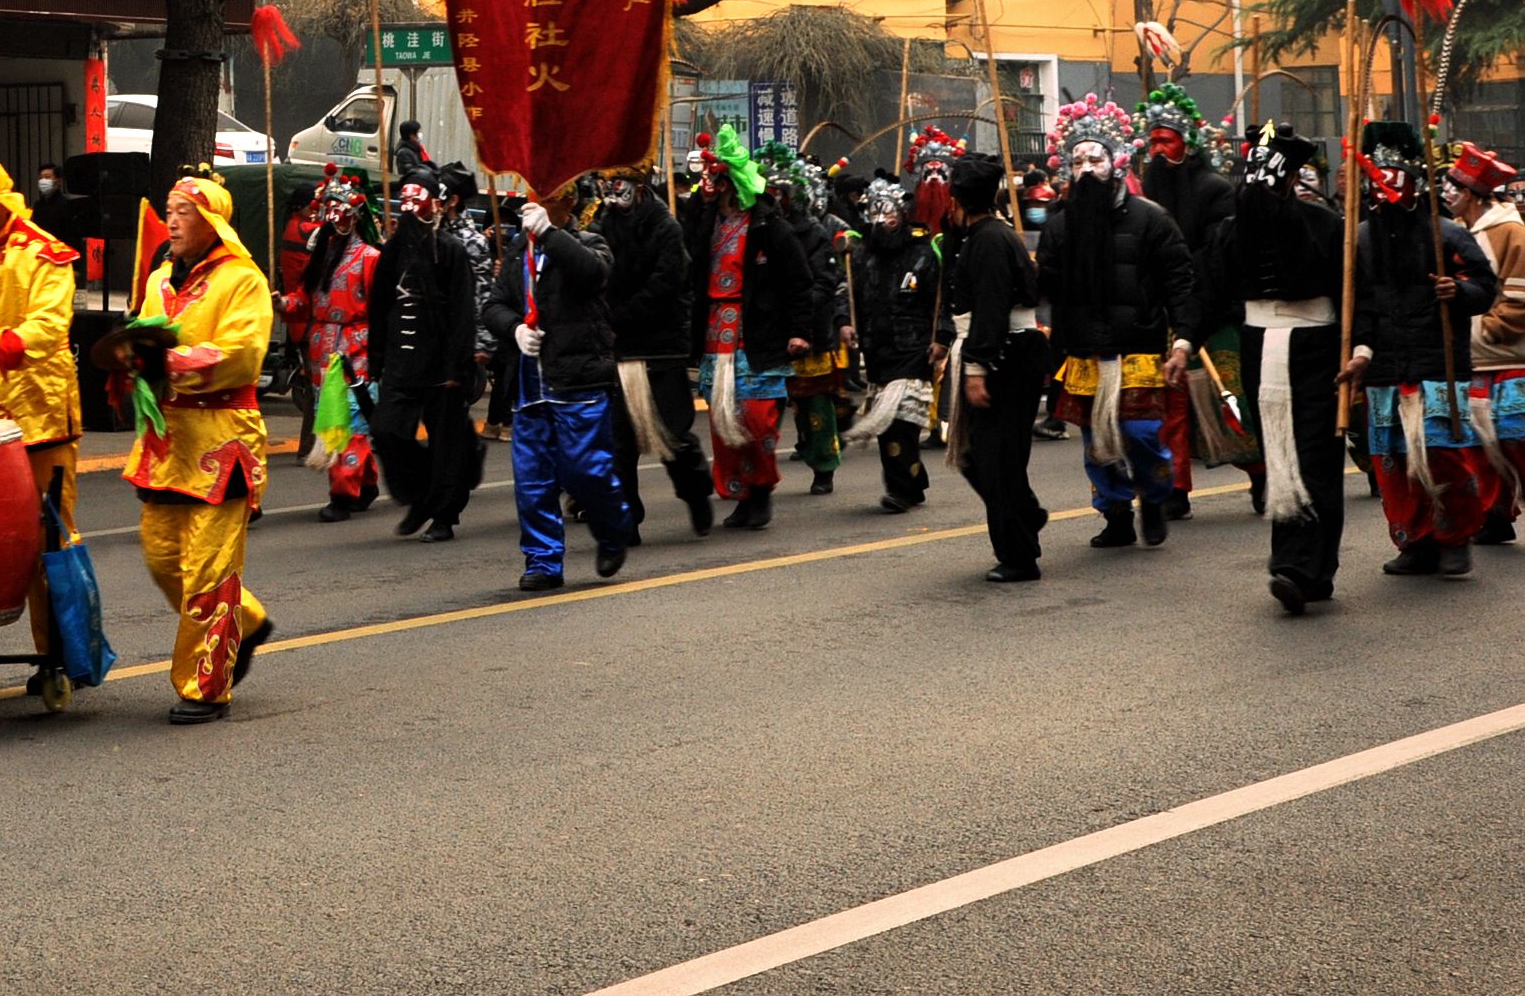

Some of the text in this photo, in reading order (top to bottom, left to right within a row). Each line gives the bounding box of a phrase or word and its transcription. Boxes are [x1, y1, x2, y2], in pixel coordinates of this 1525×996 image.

[382, 31, 445, 49] 桃洼街
[395, 51, 417, 60] TAOWA
[456, 8, 484, 142] 井陉县小作
